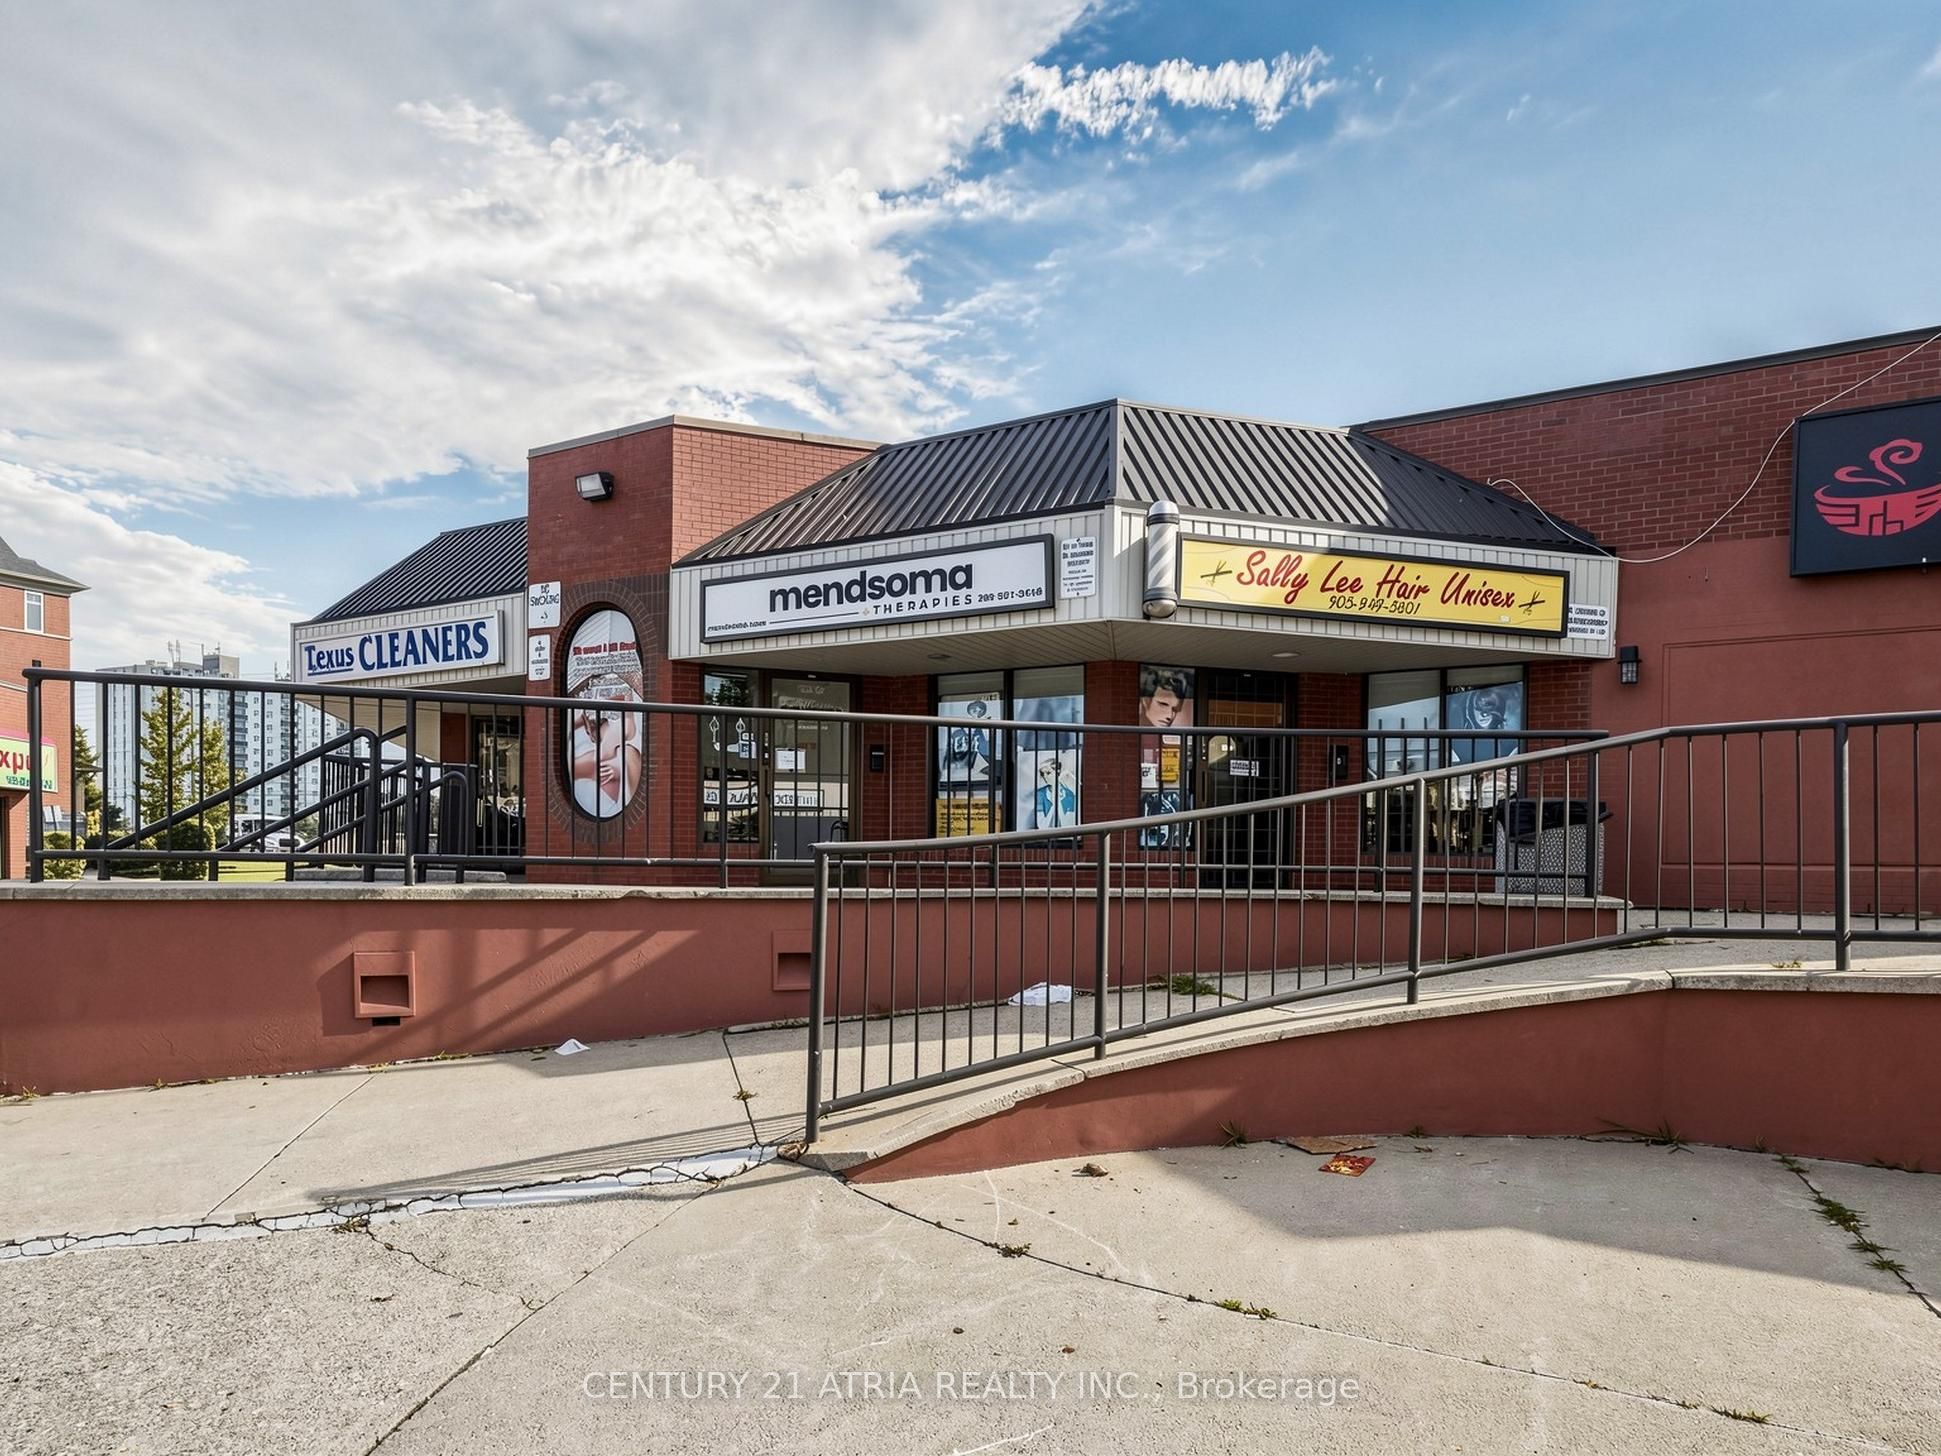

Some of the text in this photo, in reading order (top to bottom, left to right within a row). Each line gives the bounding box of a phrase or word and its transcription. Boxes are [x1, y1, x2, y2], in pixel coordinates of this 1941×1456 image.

[769, 563, 973, 613] mendsoma
[1236, 550, 1515, 608] Sally Lee Hair Unisex
[873, 594, 972, 615] THERAPIES
[359, 621, 489, 671] CLEANERS
